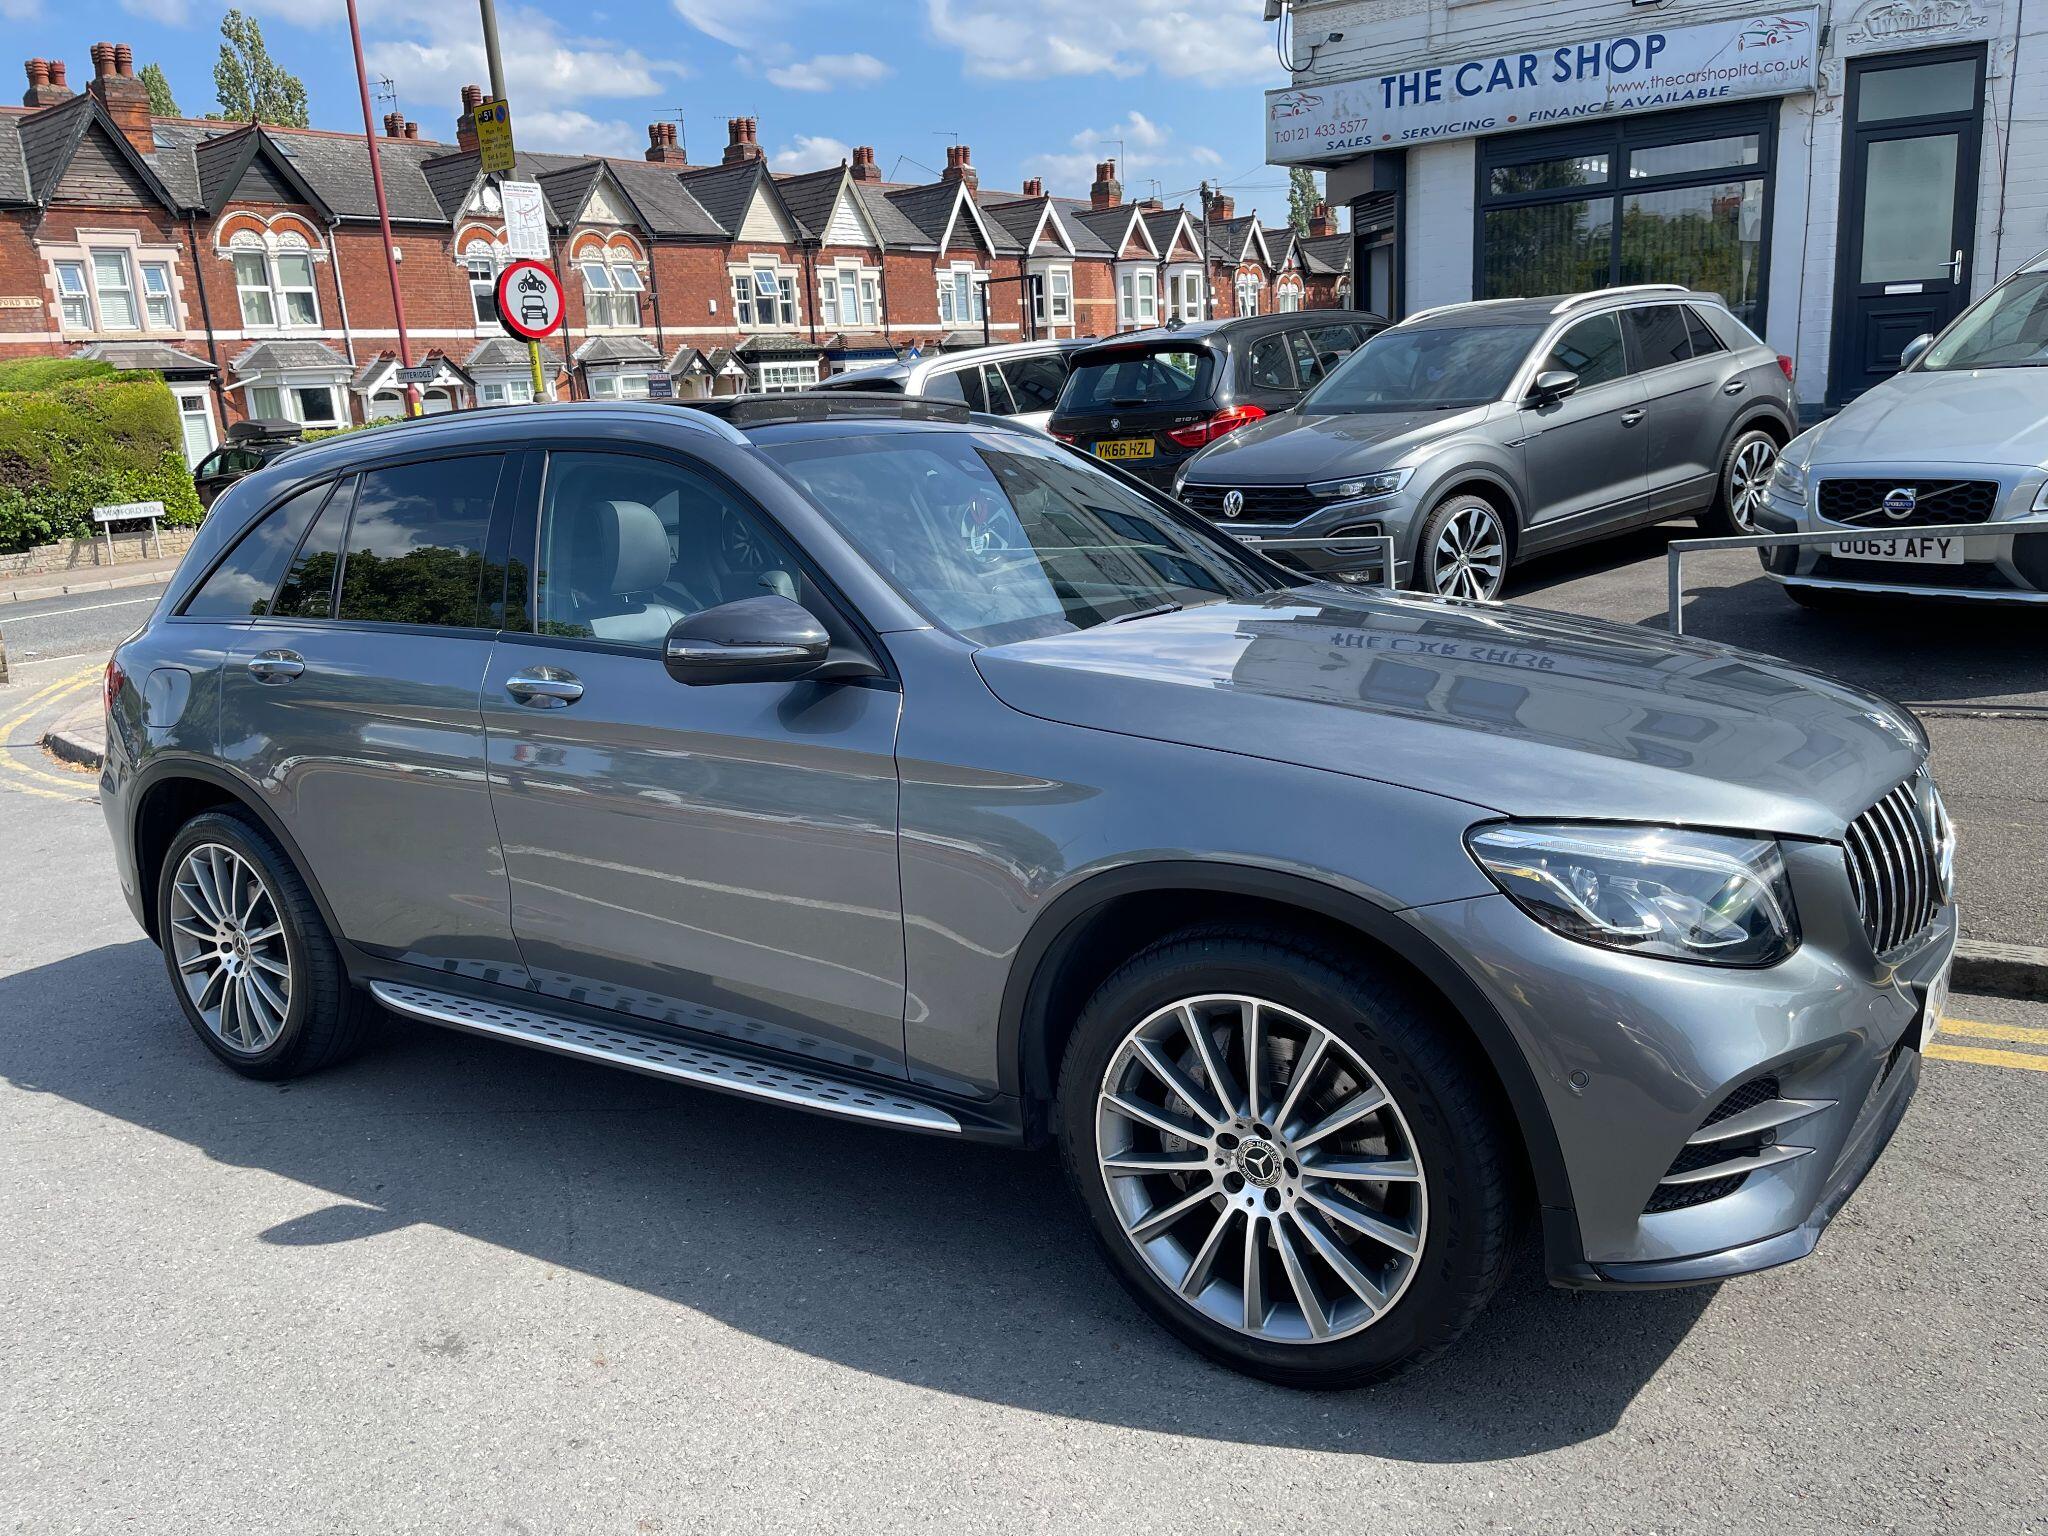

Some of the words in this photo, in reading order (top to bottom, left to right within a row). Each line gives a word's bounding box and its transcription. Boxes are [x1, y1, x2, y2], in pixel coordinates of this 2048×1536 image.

[1380, 68, 1442, 109] THE
[1455, 53, 1538, 97] CAR
[1552, 33, 1666, 83] SHOP
[1606, 55, 1809, 94] www.thecarshopltd.co.uk
[1275, 127, 1309, 143] T:0121
[1314, 123, 1336, 137] 433
[1339, 118, 1368, 134] 5577
[1326, 135, 1372, 150] SALES
[1401, 117, 1496, 140] SERVICING
[1529, 100, 1615, 122] FINANCE
[1621, 85, 1730, 108] AVAILABLE
[1098, 443, 1126, 457] YK66
[1129, 442, 1151, 455] HZL
[1904, 537, 1951, 559] AFY
